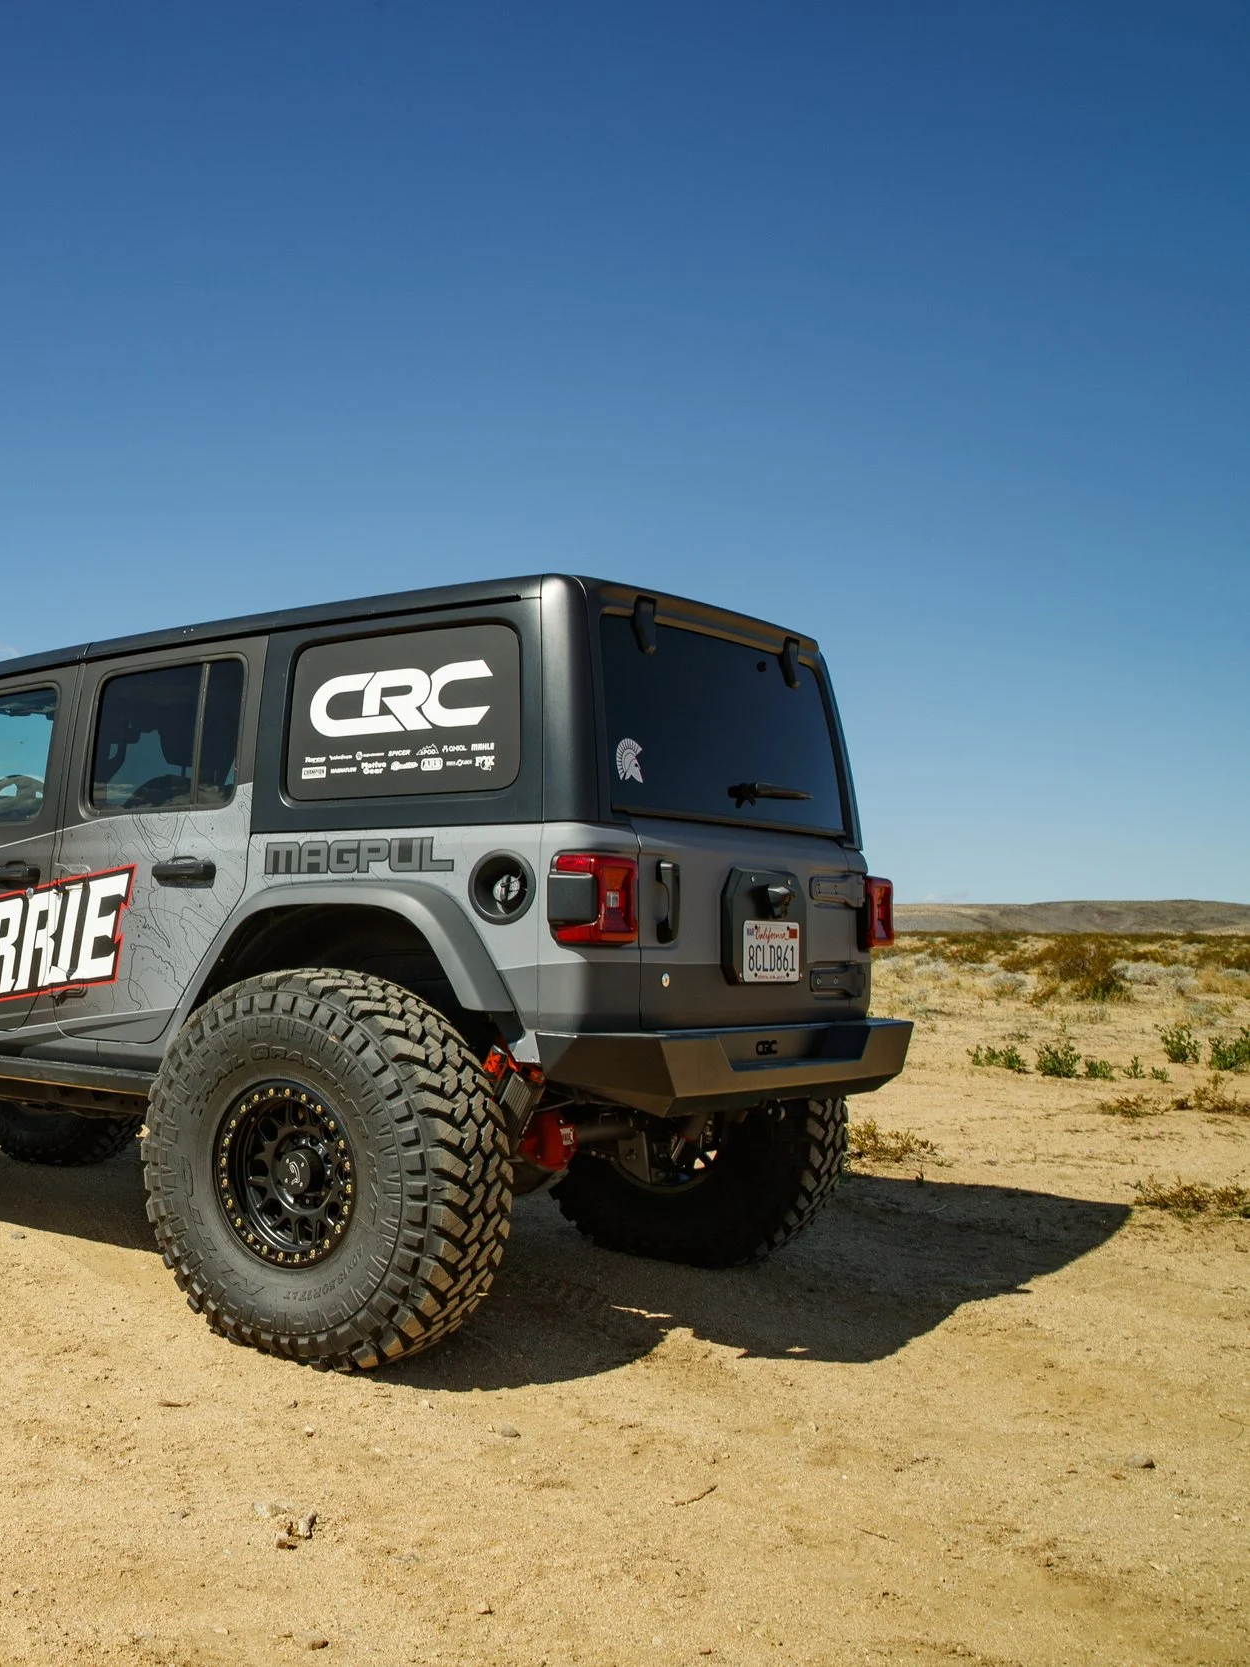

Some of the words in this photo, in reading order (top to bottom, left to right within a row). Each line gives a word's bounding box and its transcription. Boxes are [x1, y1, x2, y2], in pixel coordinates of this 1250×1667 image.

[310, 659, 493, 738] CRC
[388, 749, 411, 757] SPICER
[471, 742, 494, 751] MAHLE
[361, 761, 387, 769] Motive
[265, 837, 454, 874] MAGPUL
[755, 926, 789, 944] California
[749, 945, 796, 972] 8CLD861
[756, 1040, 778, 1056] CRC
